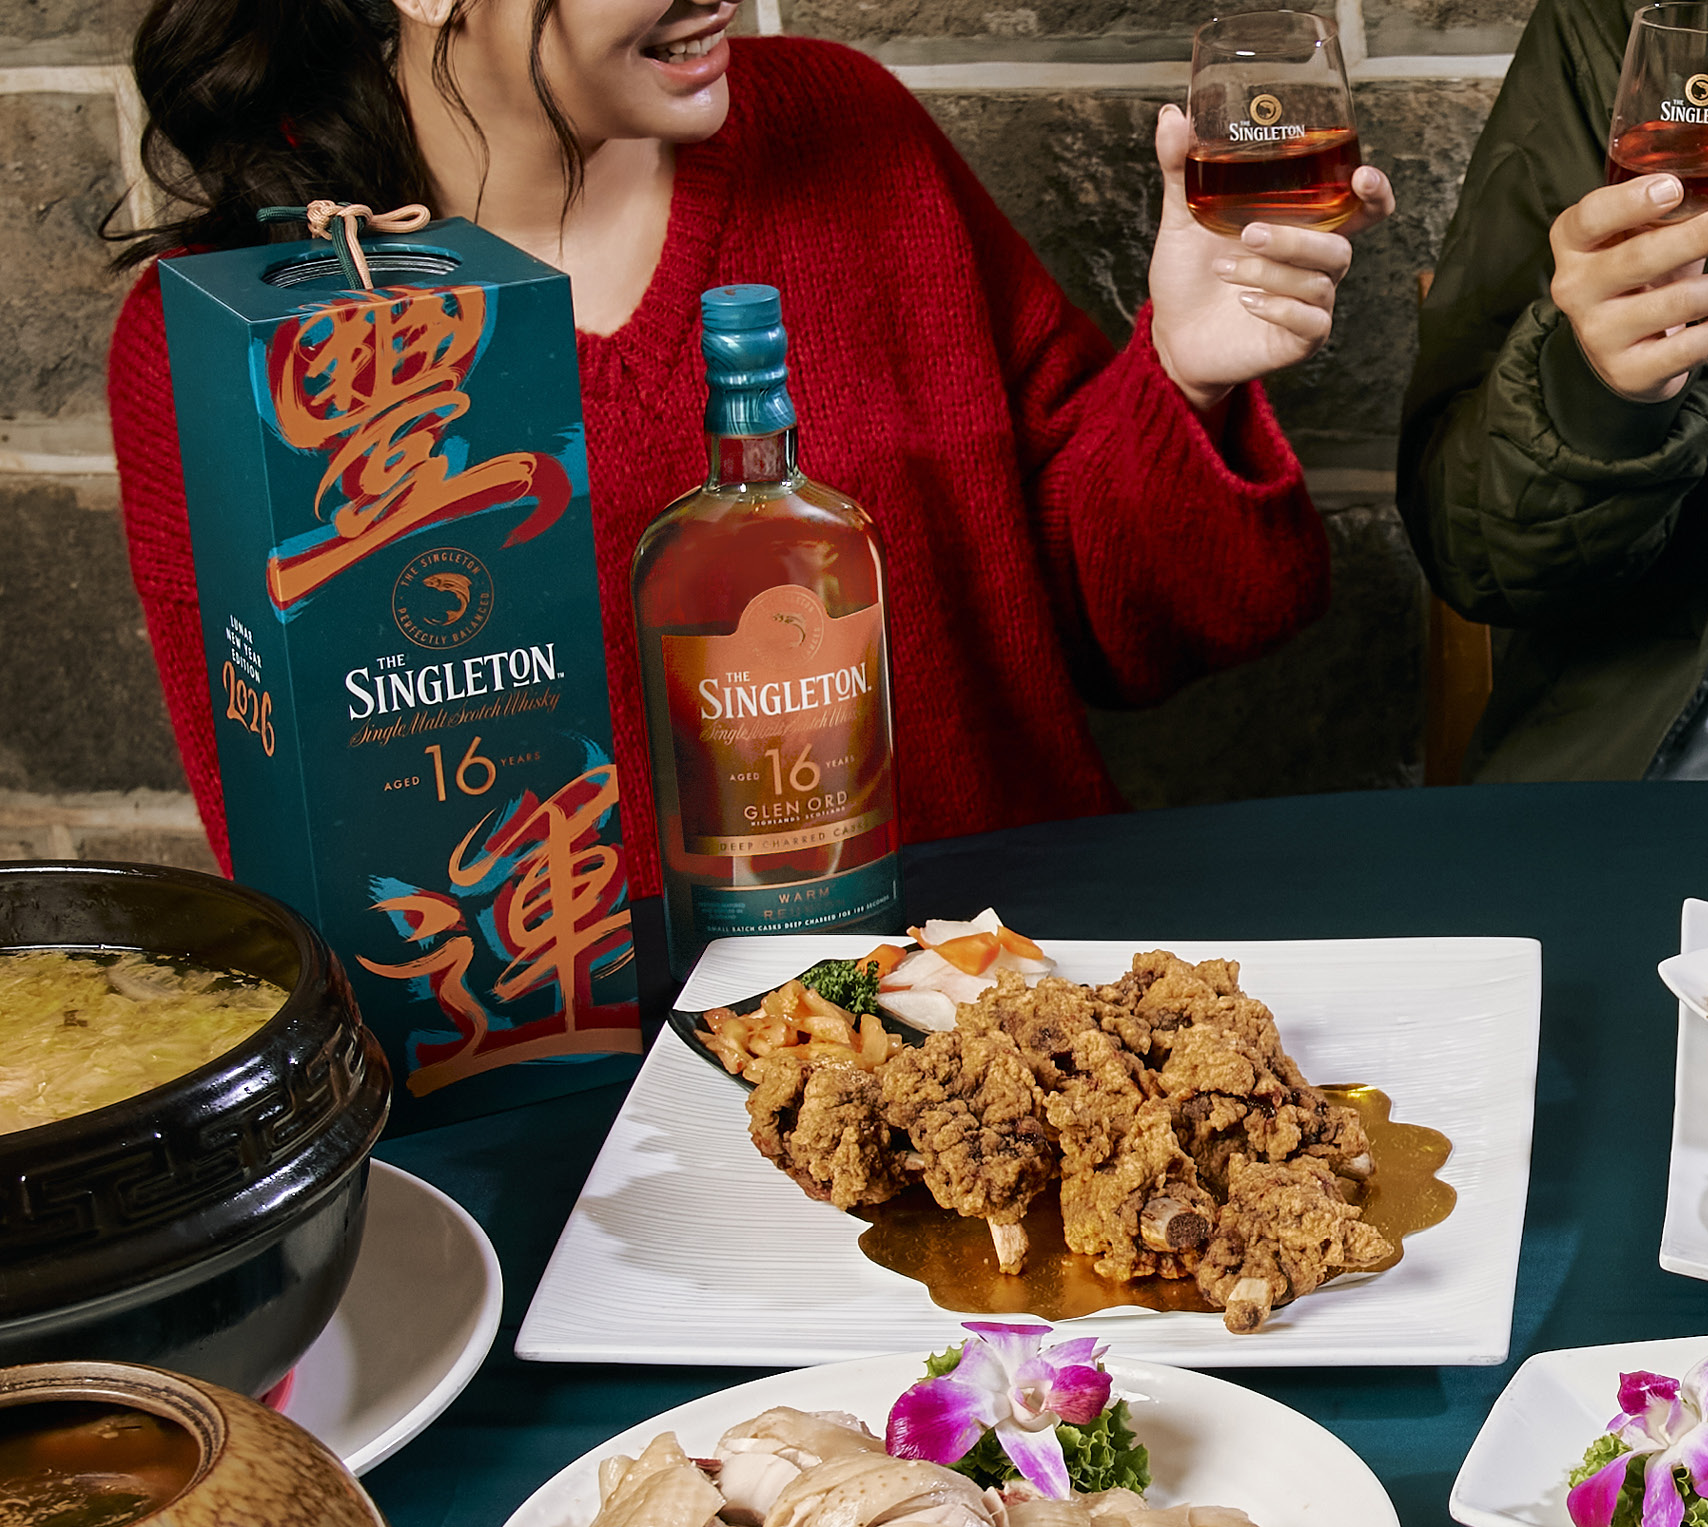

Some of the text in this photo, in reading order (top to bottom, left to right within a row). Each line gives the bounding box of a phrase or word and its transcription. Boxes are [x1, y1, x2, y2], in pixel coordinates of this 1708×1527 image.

[1229, 123, 1306, 141] SINGLETON
[400, 552, 481, 587] THE SINGLETON
[229, 614, 254, 644] LUNAR
[398, 593, 490, 645] PERFECTLY BALANCED
[225, 627, 262, 669] NEW YEAR
[231, 648, 261, 684] EDITION
[376, 653, 406, 670] THE
[345, 643, 556, 721] SINGLETON
[698, 662, 867, 720] SINGLETON
[725, 671, 750, 683] THE
[222, 660, 275, 757] 2026
[349, 687, 561, 747] Single Malt Scotch Whisky
[384, 735, 541, 802] AGED 16 YEARS
[729, 743, 855, 795] AGED 16 YEARS
[744, 790, 848, 820] GLEN ORD
[751, 806, 846, 827] HIGHLANDS SCOTLAND
[720, 842, 753, 852] DEEP
[762, 832, 825, 849] CHARRED
[778, 887, 830, 904] WARM
[356, 763, 644, 1098] 運
